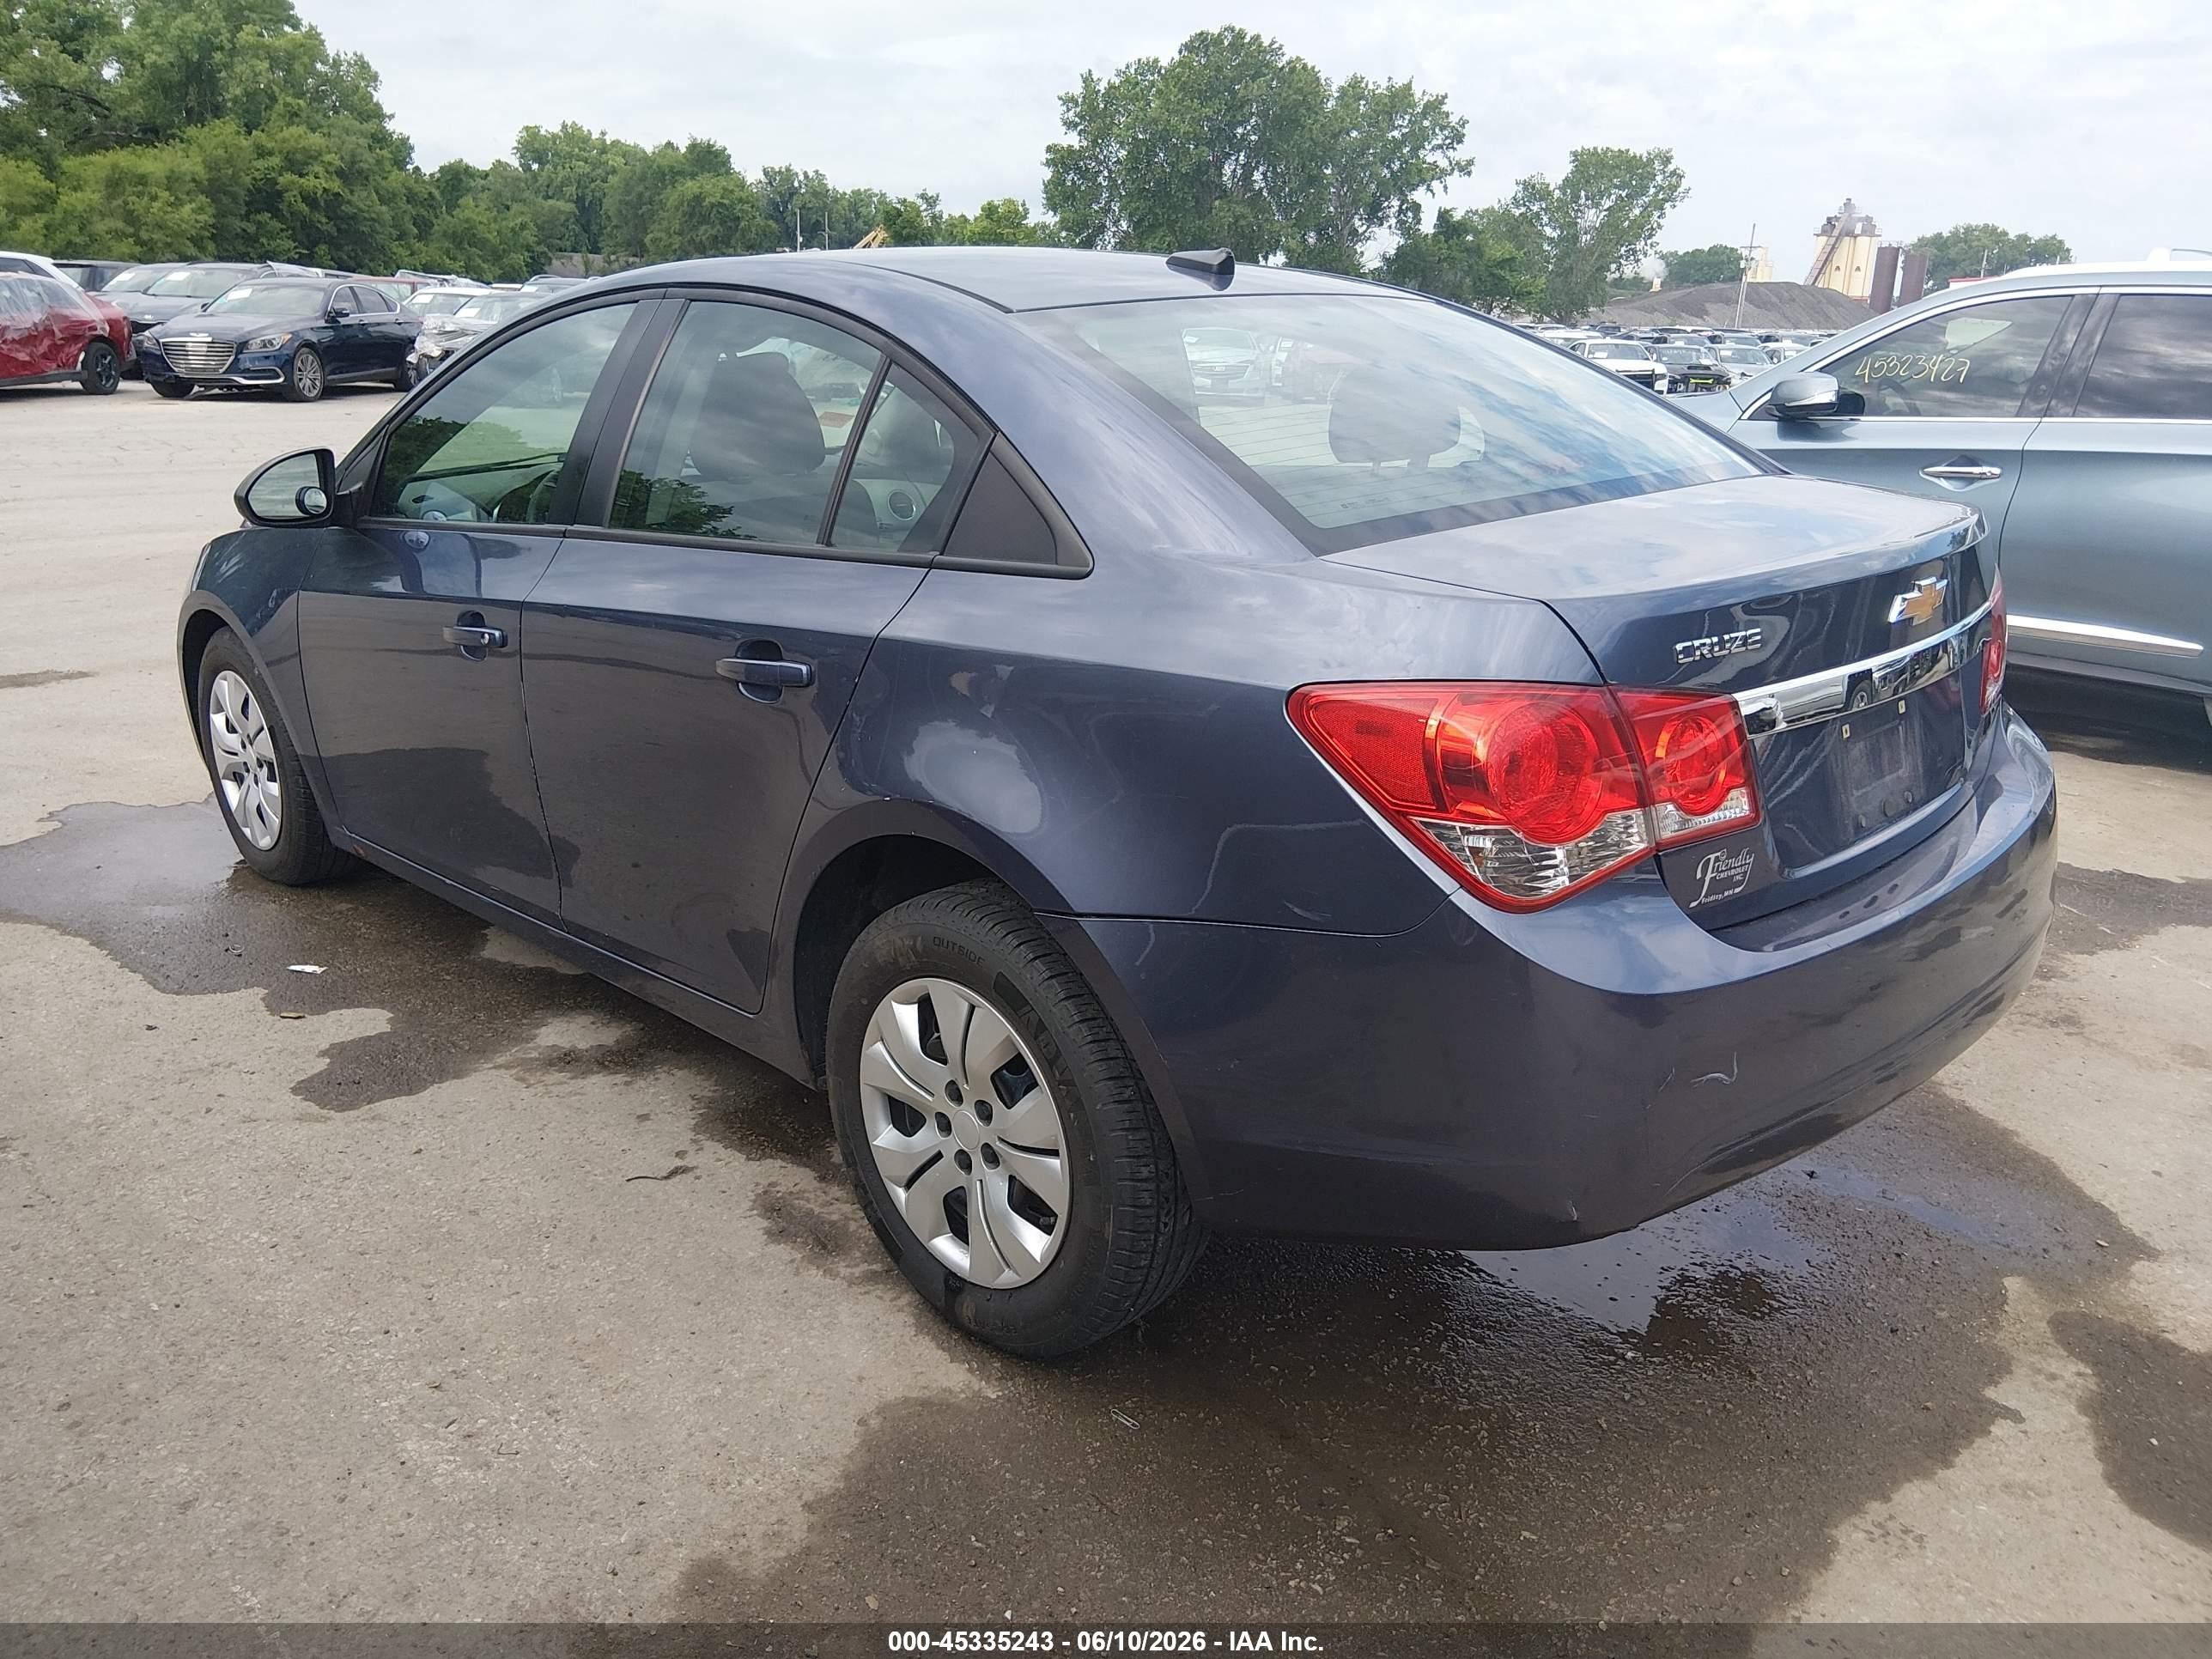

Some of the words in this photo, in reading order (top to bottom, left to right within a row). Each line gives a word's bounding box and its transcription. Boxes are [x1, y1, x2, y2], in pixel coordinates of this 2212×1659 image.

[1854, 354, 1972, 384] 45323427
[1674, 629, 1761, 664] CRUZE
[1717, 865, 1748, 880] CHEVROLET
[933, 936, 986, 967] OUTSIDE
